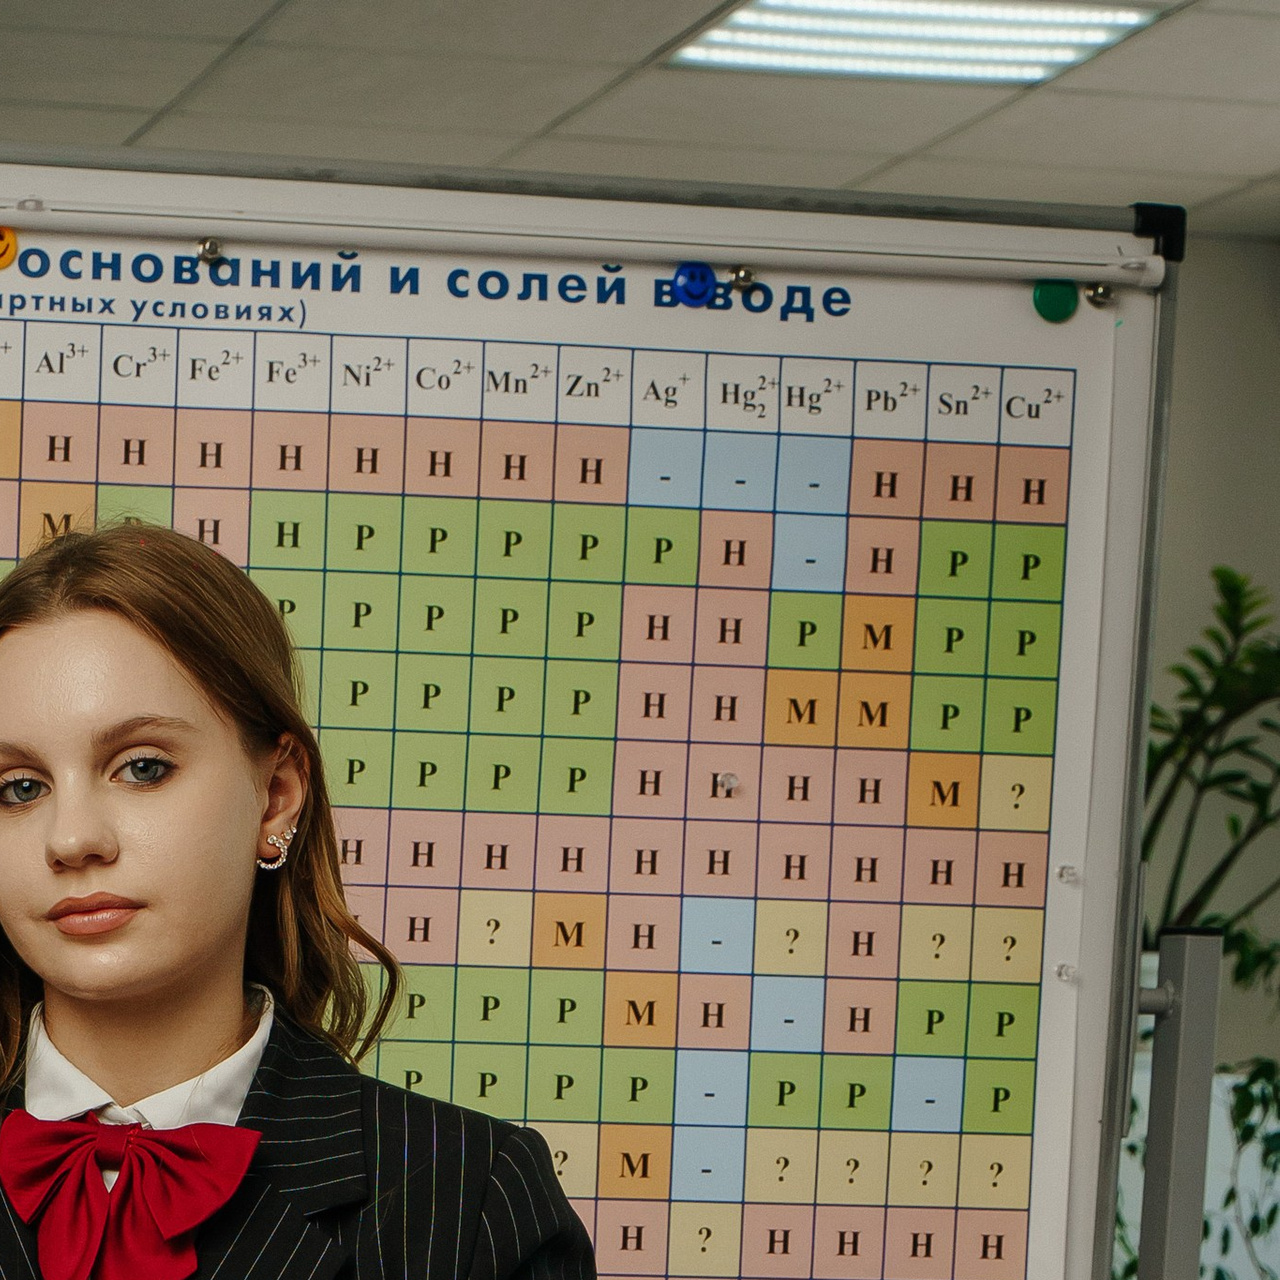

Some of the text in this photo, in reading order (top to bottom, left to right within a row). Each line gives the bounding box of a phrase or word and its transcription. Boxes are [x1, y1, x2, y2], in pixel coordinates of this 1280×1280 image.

[17, 246, 361, 294] оснований
[391, 265, 420, 295] и
[446, 264, 626, 306] солей
[129, 298, 307, 330] условиях)
[34, 342, 89, 375] Al3+
[112, 346, 171, 378] Cr3+
[189, 349, 244, 382] Fe2+
[266, 352, 321, 385] Fe3+
[342, 355, 395, 388] Ni2+
[415, 358, 475, 391] Co2+
[485, 362, 552, 395] Mn2+
[565, 366, 624, 398] Zn2+
[642, 373, 690, 409] Ag+
[786, 377, 844, 415] Hg2+
[865, 381, 921, 413] Pb2+
[937, 384, 993, 416] Sn2+
[1005, 387, 1065, 420] Cu2+
[46, 434, 73, 463] Н
[121, 438, 147, 466] Н
[198, 441, 224, 469] Н
[277, 444, 303, 472] Н
[354, 446, 380, 475] Н
[427, 449, 453, 478] Н
[502, 453, 528, 482] Н
[578, 457, 604, 485] Н
[872, 470, 899, 499] Н
[949, 474, 975, 503] Н
[1021, 477, 1047, 506] Н
[1020, 553, 1042, 581] Р
[1016, 629, 1037, 657] Р
[1012, 706, 1033, 734] Р
[1000, 861, 1026, 889] Н
[995, 1011, 1016, 1038] Р
[990, 1086, 1011, 1113] Р
[979, 1233, 1005, 1261] Н
